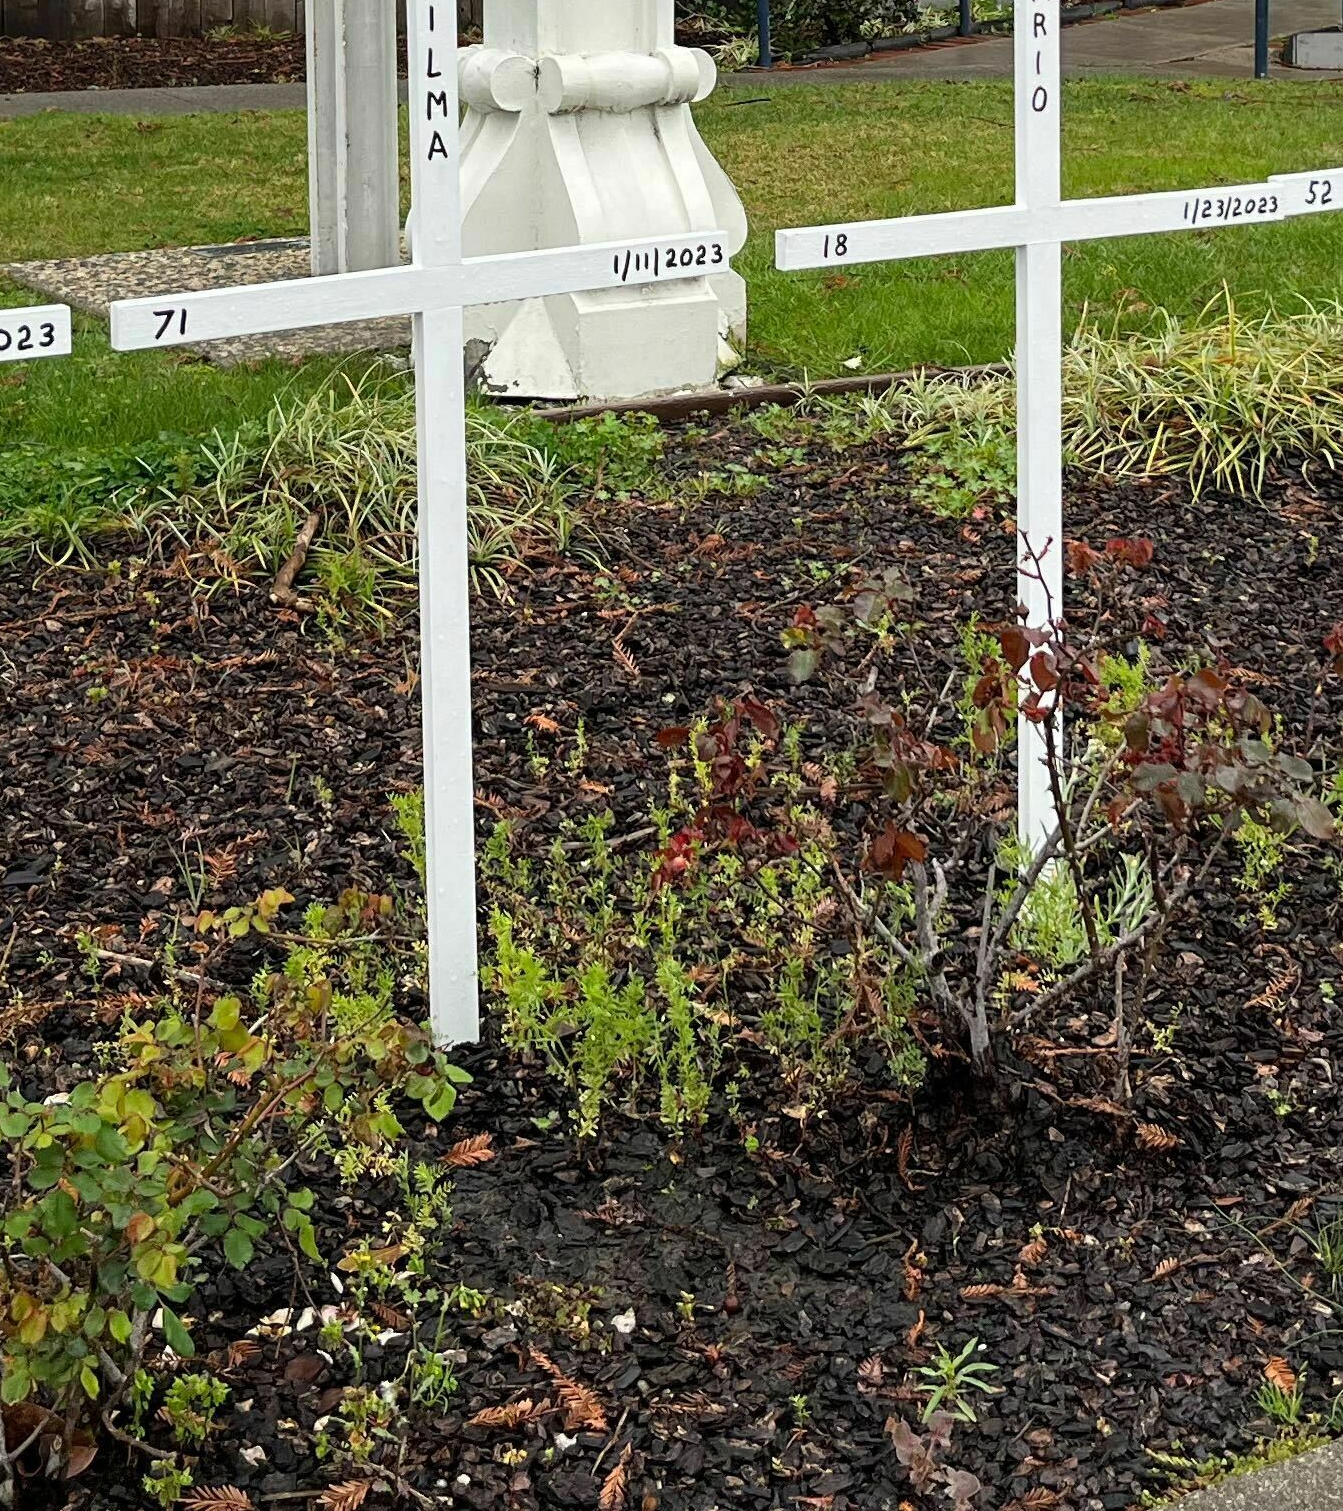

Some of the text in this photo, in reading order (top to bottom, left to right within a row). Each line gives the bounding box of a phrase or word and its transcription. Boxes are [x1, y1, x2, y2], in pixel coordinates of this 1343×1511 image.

[1304, 180, 1332, 205] 52
[1183, 196, 1278, 225] 1/23/2023
[823, 233, 848, 258] 18
[613, 244, 724, 282] 1/11/2023
[153, 309, 186, 339] 71
